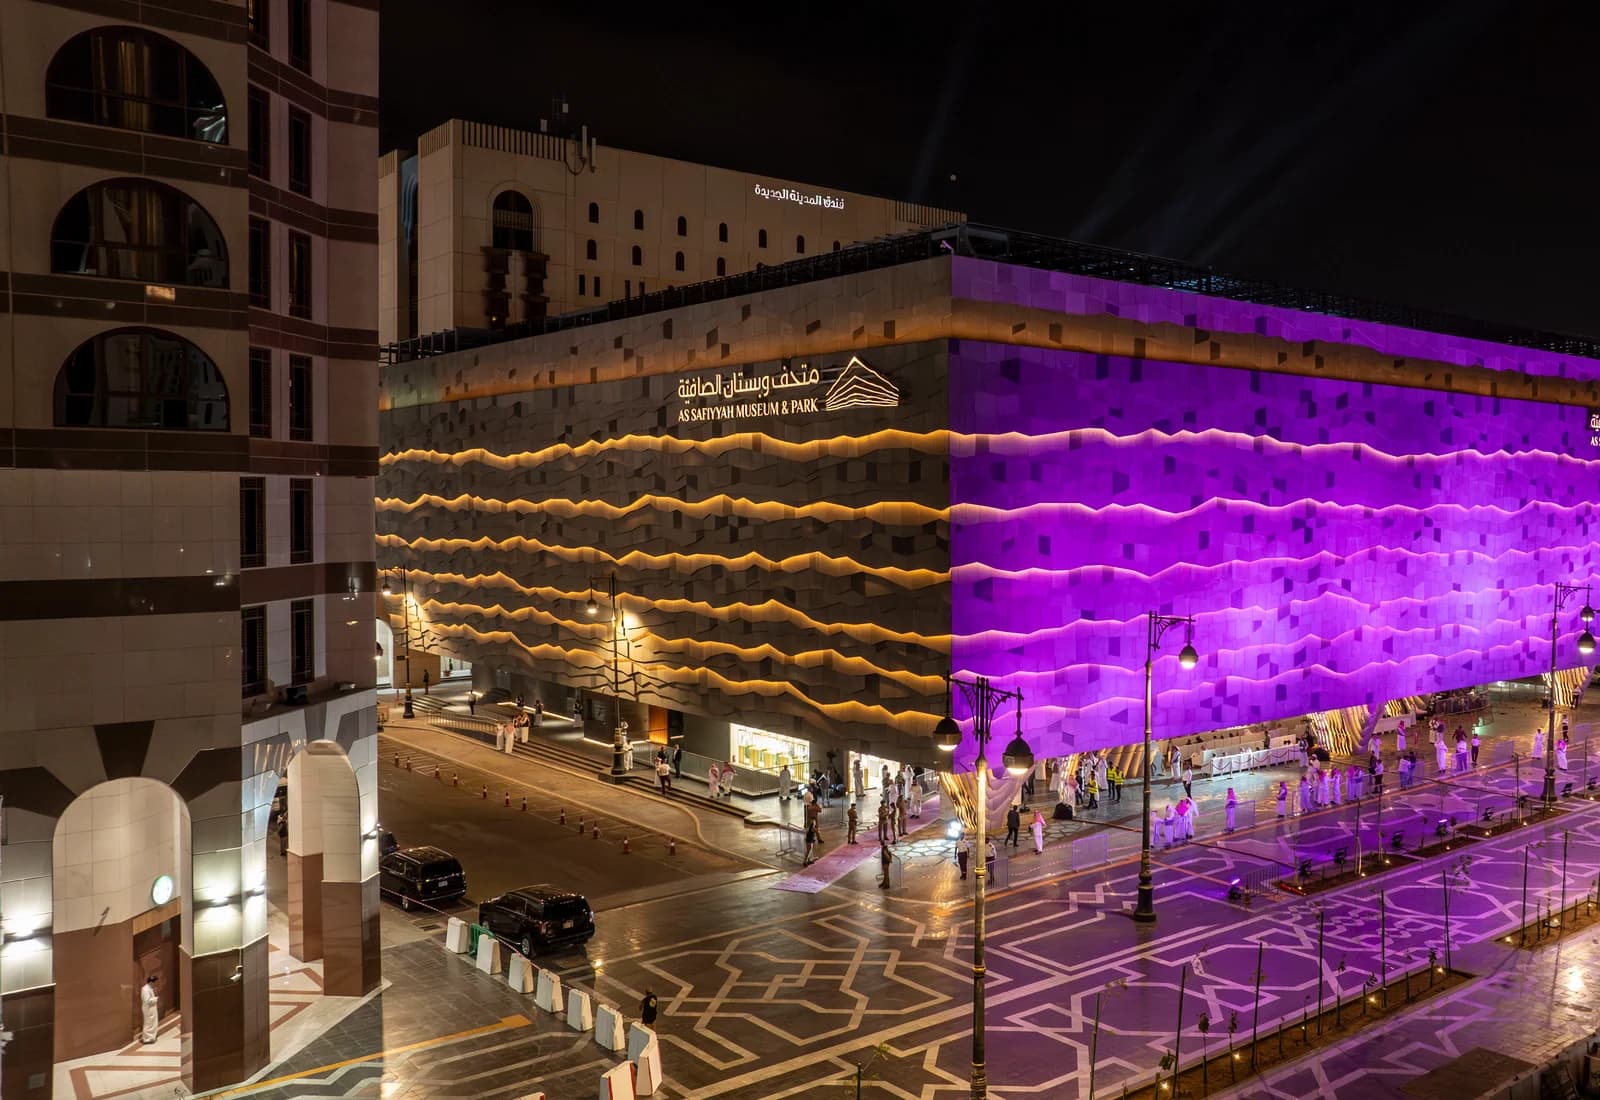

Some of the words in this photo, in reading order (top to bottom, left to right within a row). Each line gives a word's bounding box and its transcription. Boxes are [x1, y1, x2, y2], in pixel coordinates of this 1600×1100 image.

[754, 183, 789, 200] الجديدة
[789, 189, 822, 205] المدينة
[823, 196, 845, 210] فندق
[723, 371, 770, 399] وبستان
[771, 363, 820, 389] متحف
[678, 408, 690, 422] AS
[690, 404, 735, 422] SAFIYYAH
[735, 401, 779, 419] MUSEUM
[781, 399, 789, 415] &
[791, 397, 819, 414] PARK
